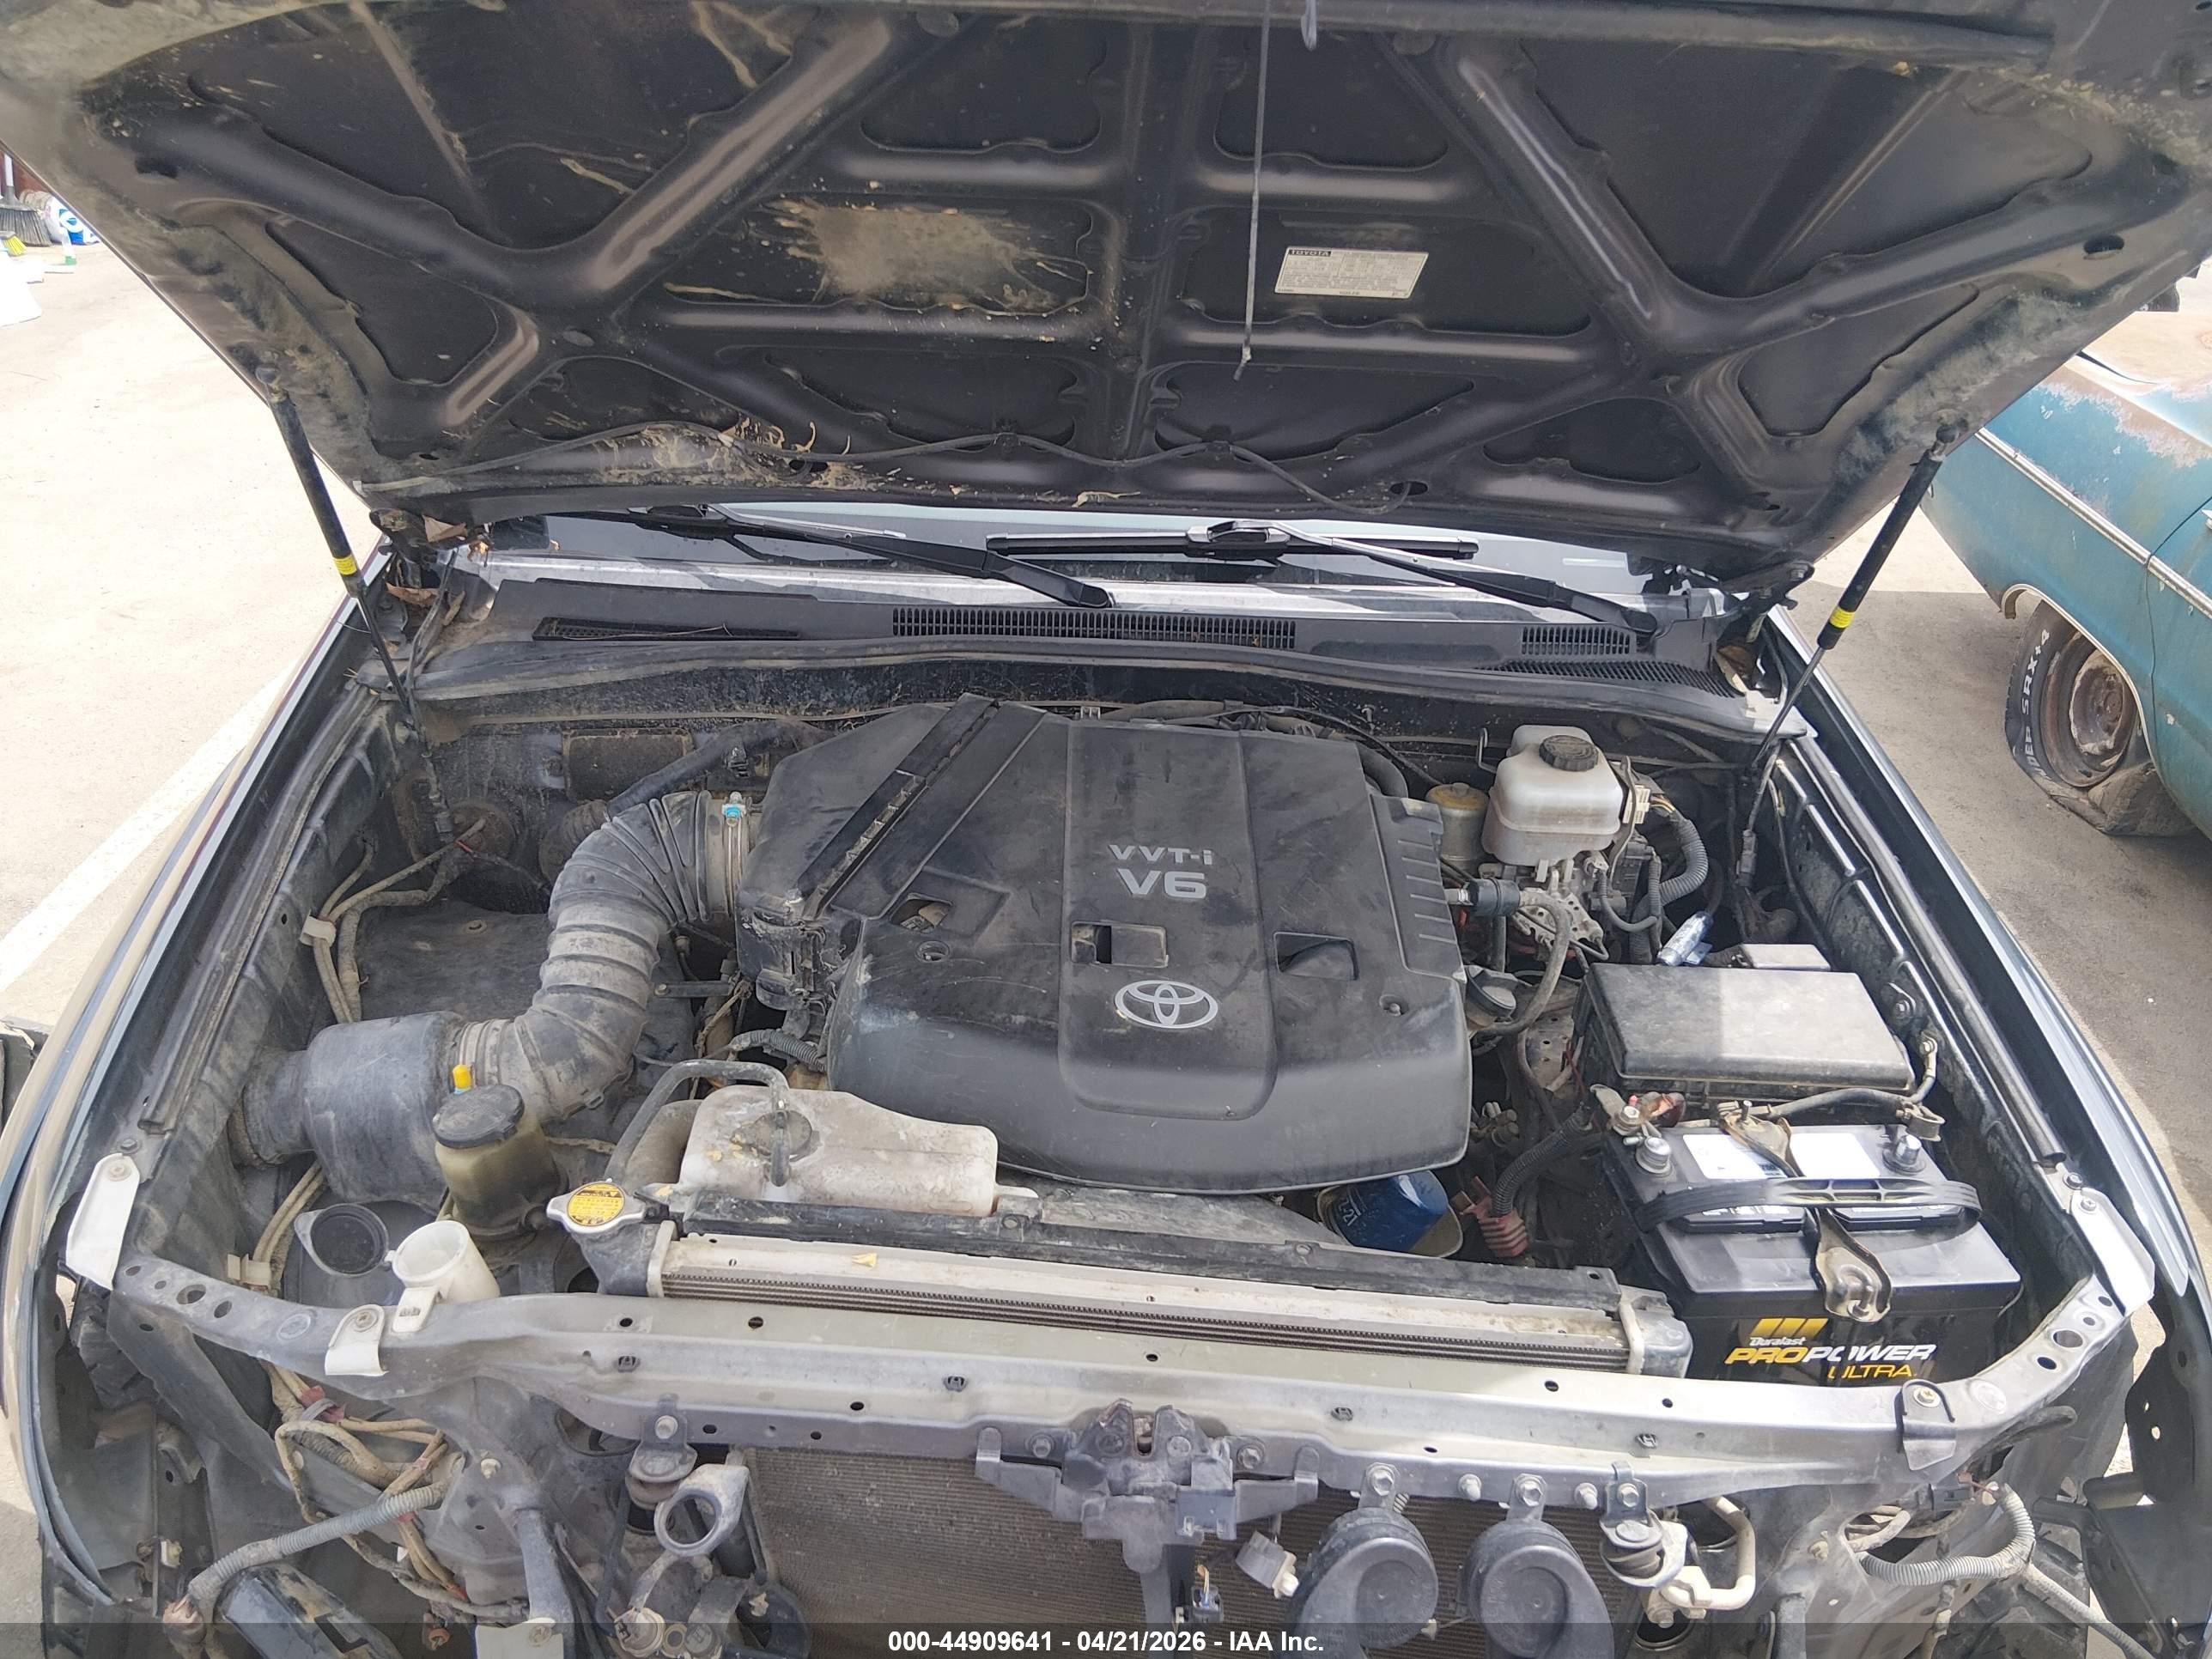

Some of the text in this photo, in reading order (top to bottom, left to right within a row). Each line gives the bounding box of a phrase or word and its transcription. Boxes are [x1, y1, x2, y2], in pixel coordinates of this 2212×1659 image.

[1109, 844, 1213, 866] VVT-i
[1117, 868, 1207, 899] V6
[1748, 1336, 1807, 1346] Duralast
[1827, 1364, 1912, 1379] ULTRA
